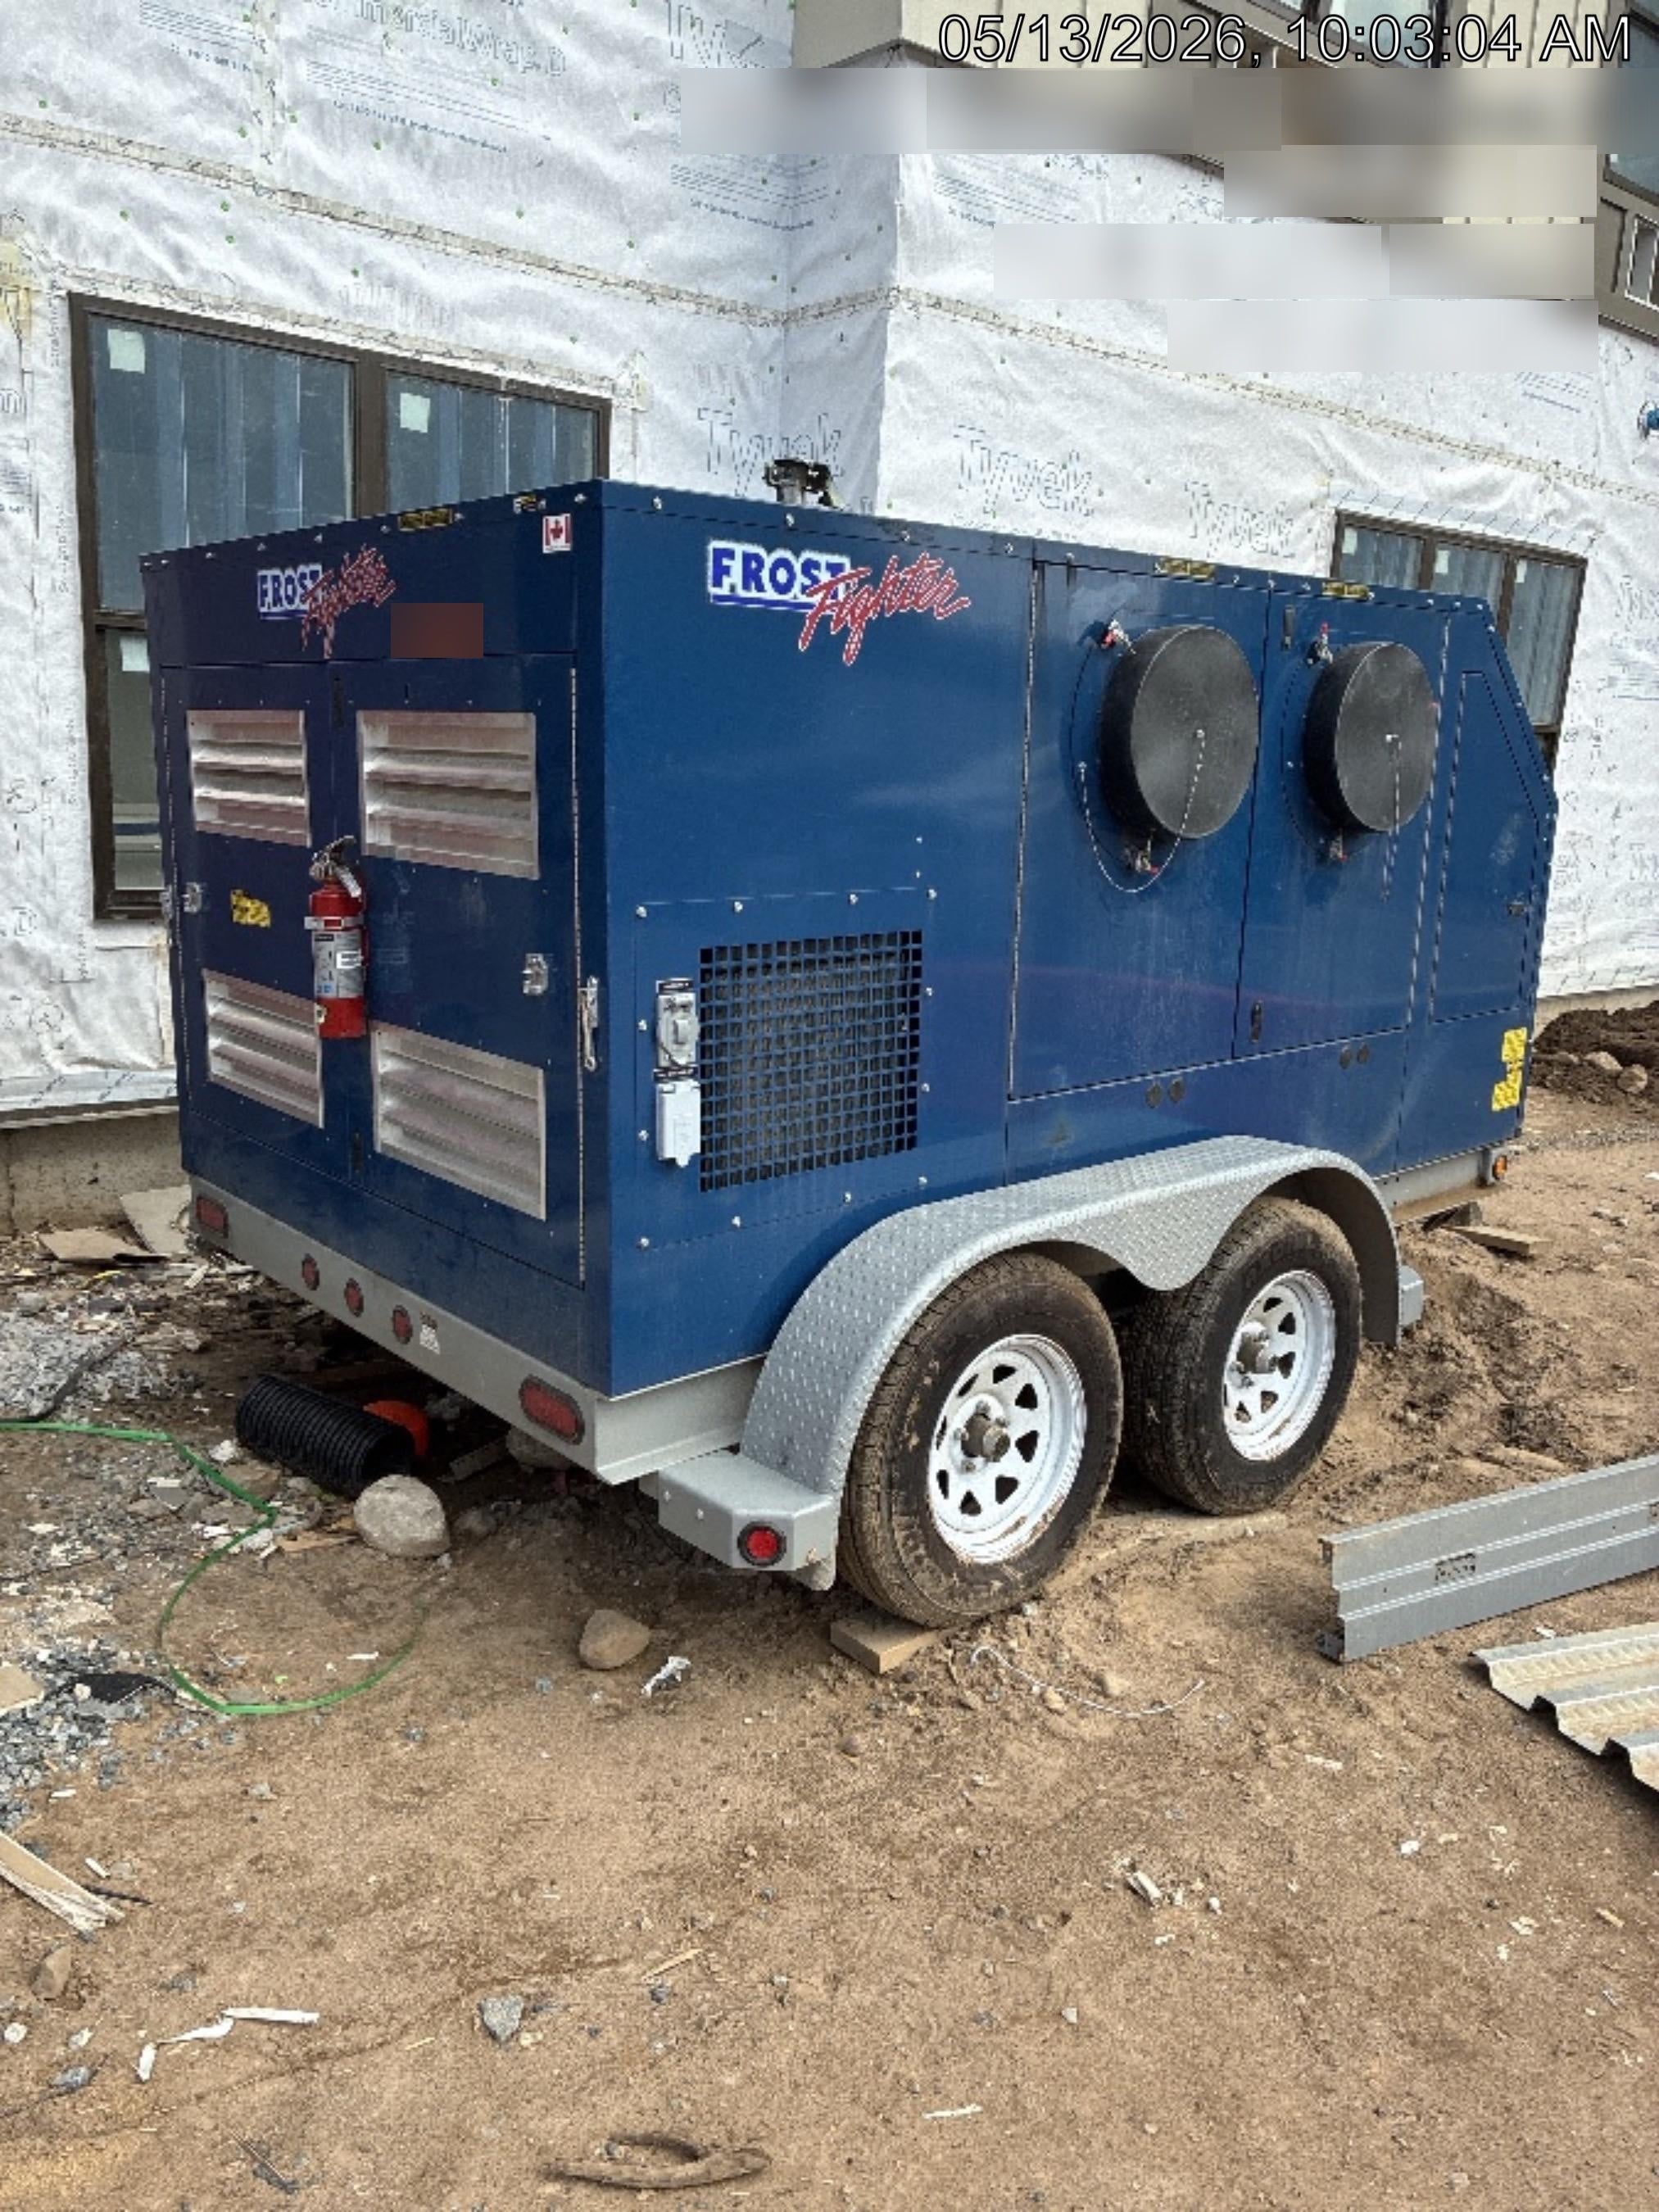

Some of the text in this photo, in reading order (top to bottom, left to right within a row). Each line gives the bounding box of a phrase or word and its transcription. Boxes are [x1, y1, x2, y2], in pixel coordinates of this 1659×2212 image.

[953, 424, 1095, 517] Tyvek
[709, 543, 972, 666] FROST Fighter
